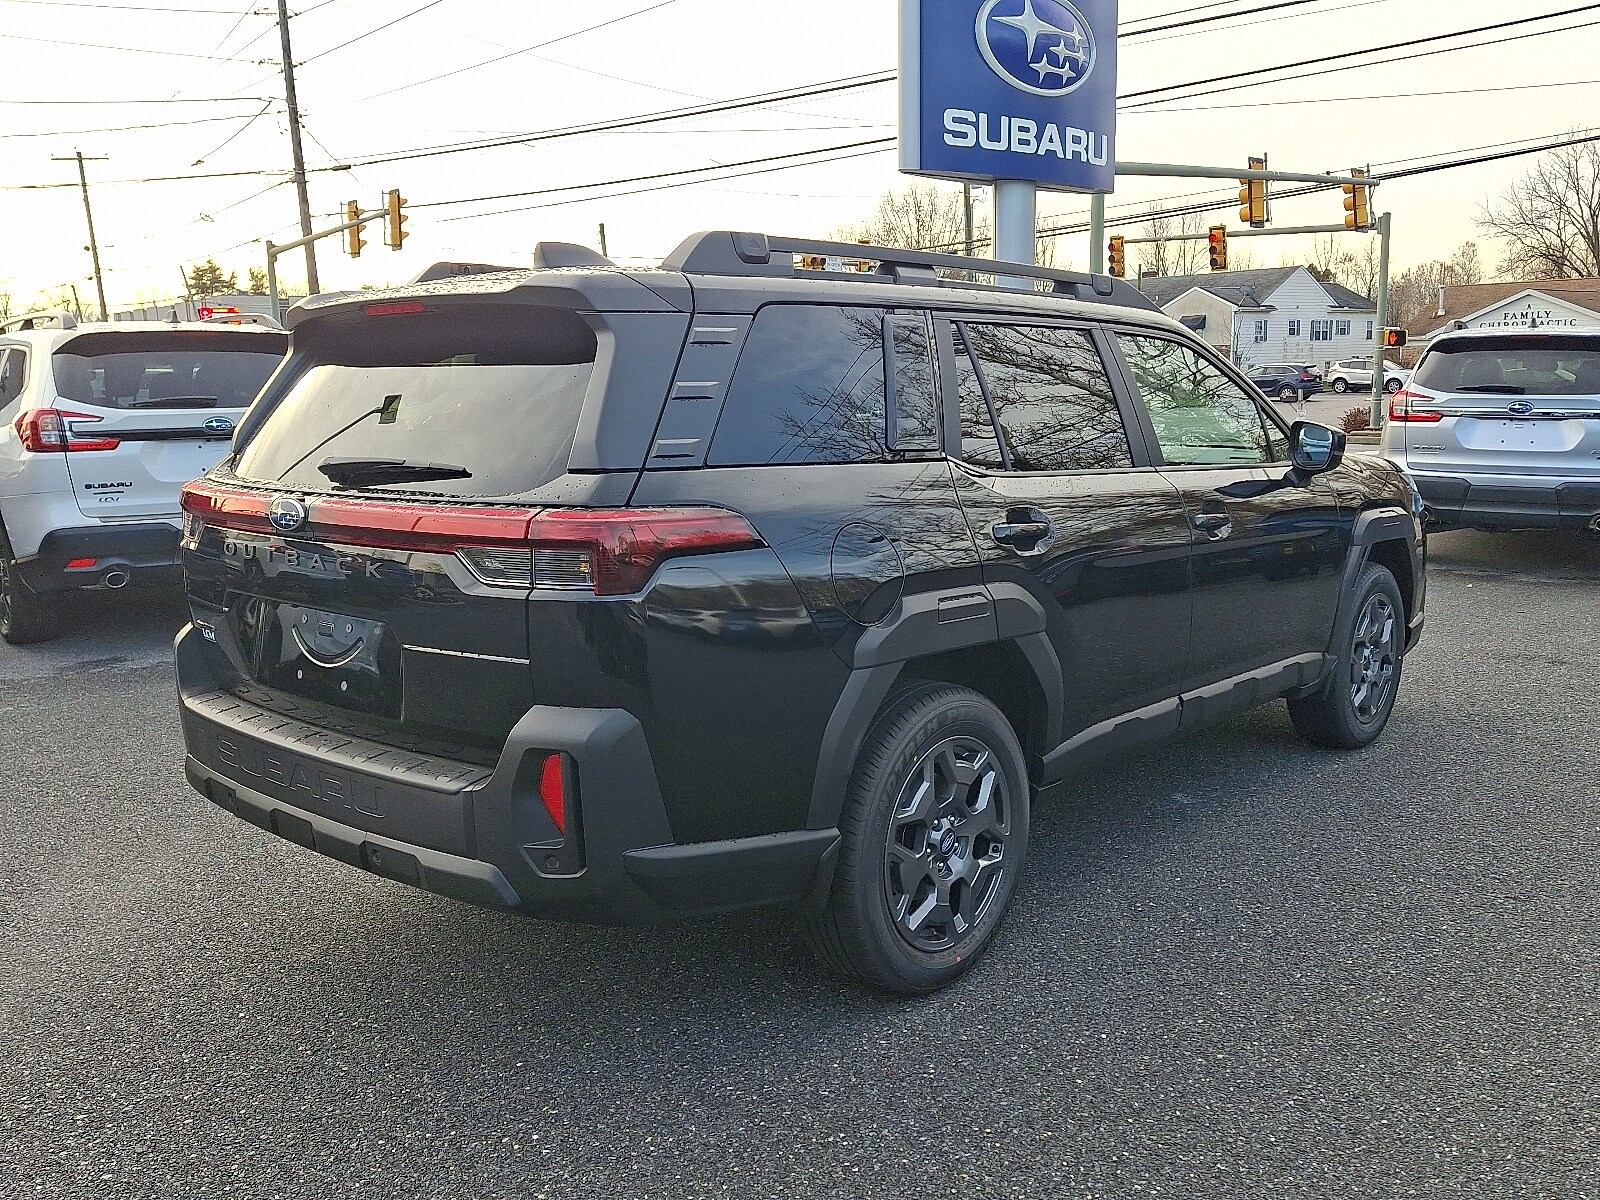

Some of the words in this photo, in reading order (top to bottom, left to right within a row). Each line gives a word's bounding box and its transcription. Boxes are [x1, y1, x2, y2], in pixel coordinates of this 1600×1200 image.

[943, 108, 1108, 167] SUBARU
[1480, 319, 1577, 329] CHIROPACTIC
[1503, 311, 1551, 320] FAMILY
[84, 481, 133, 489] SUBARU
[223, 541, 384, 579] OUTBACK
[216, 734, 386, 819] SUBARU
